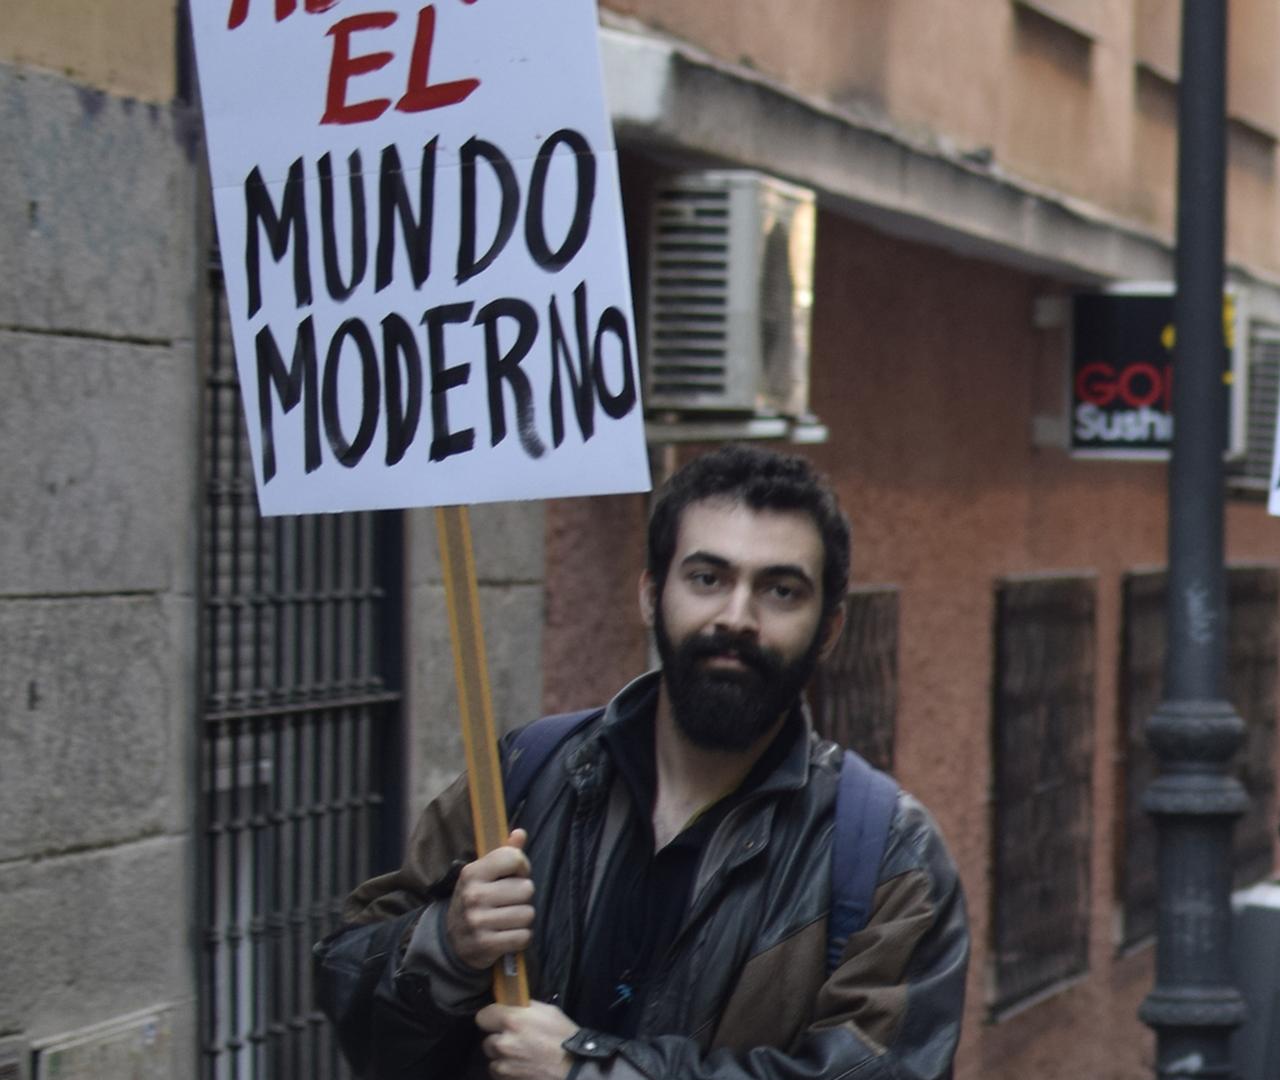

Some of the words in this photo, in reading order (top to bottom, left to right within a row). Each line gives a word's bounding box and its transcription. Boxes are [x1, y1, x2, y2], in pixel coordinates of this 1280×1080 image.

[319, 6, 481, 125] EL
[244, 128, 597, 320] MUNDO
[254, 280, 637, 486] MODERNO
[1076, 362, 1173, 412] GO
